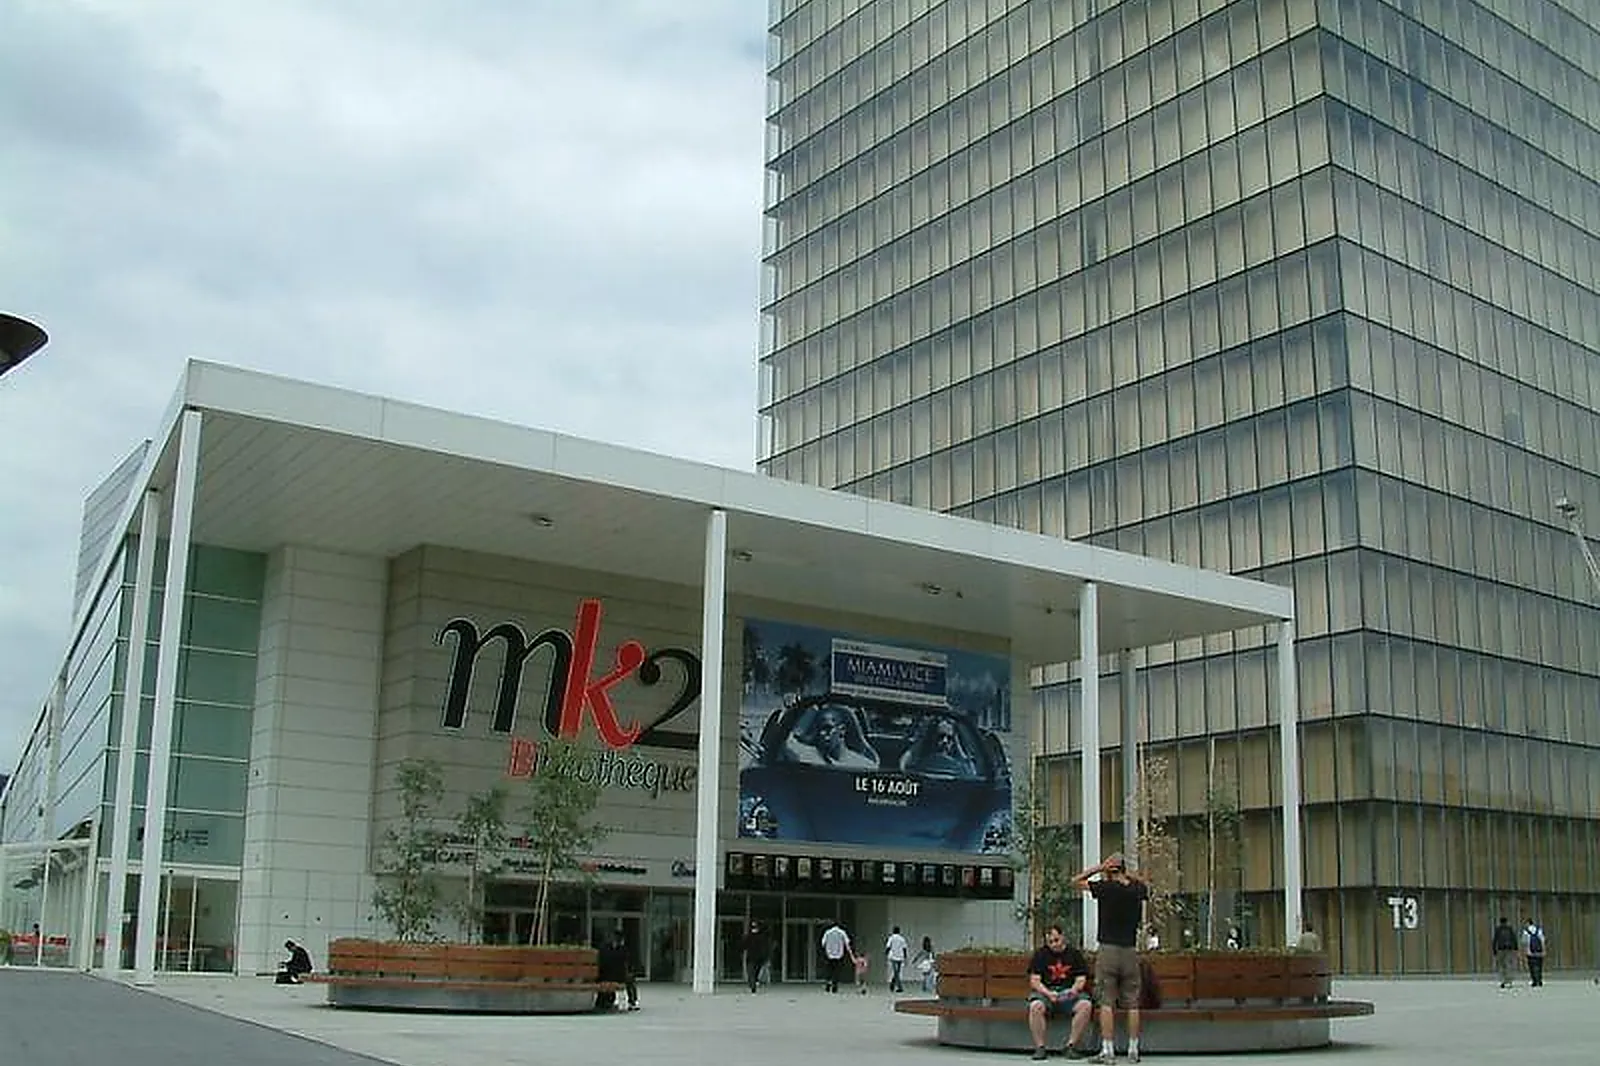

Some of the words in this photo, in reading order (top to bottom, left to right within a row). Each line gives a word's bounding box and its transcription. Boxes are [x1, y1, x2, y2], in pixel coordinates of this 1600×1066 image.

[437, 597, 700, 749] mk2
[847, 657, 897, 679] MIAMI
[898, 663, 937, 682] VICE
[855, 777, 868, 791] LE
[872, 779, 885, 793] 16
[887, 779, 919, 796] AOÛT
[1388, 897, 1418, 929] T3
